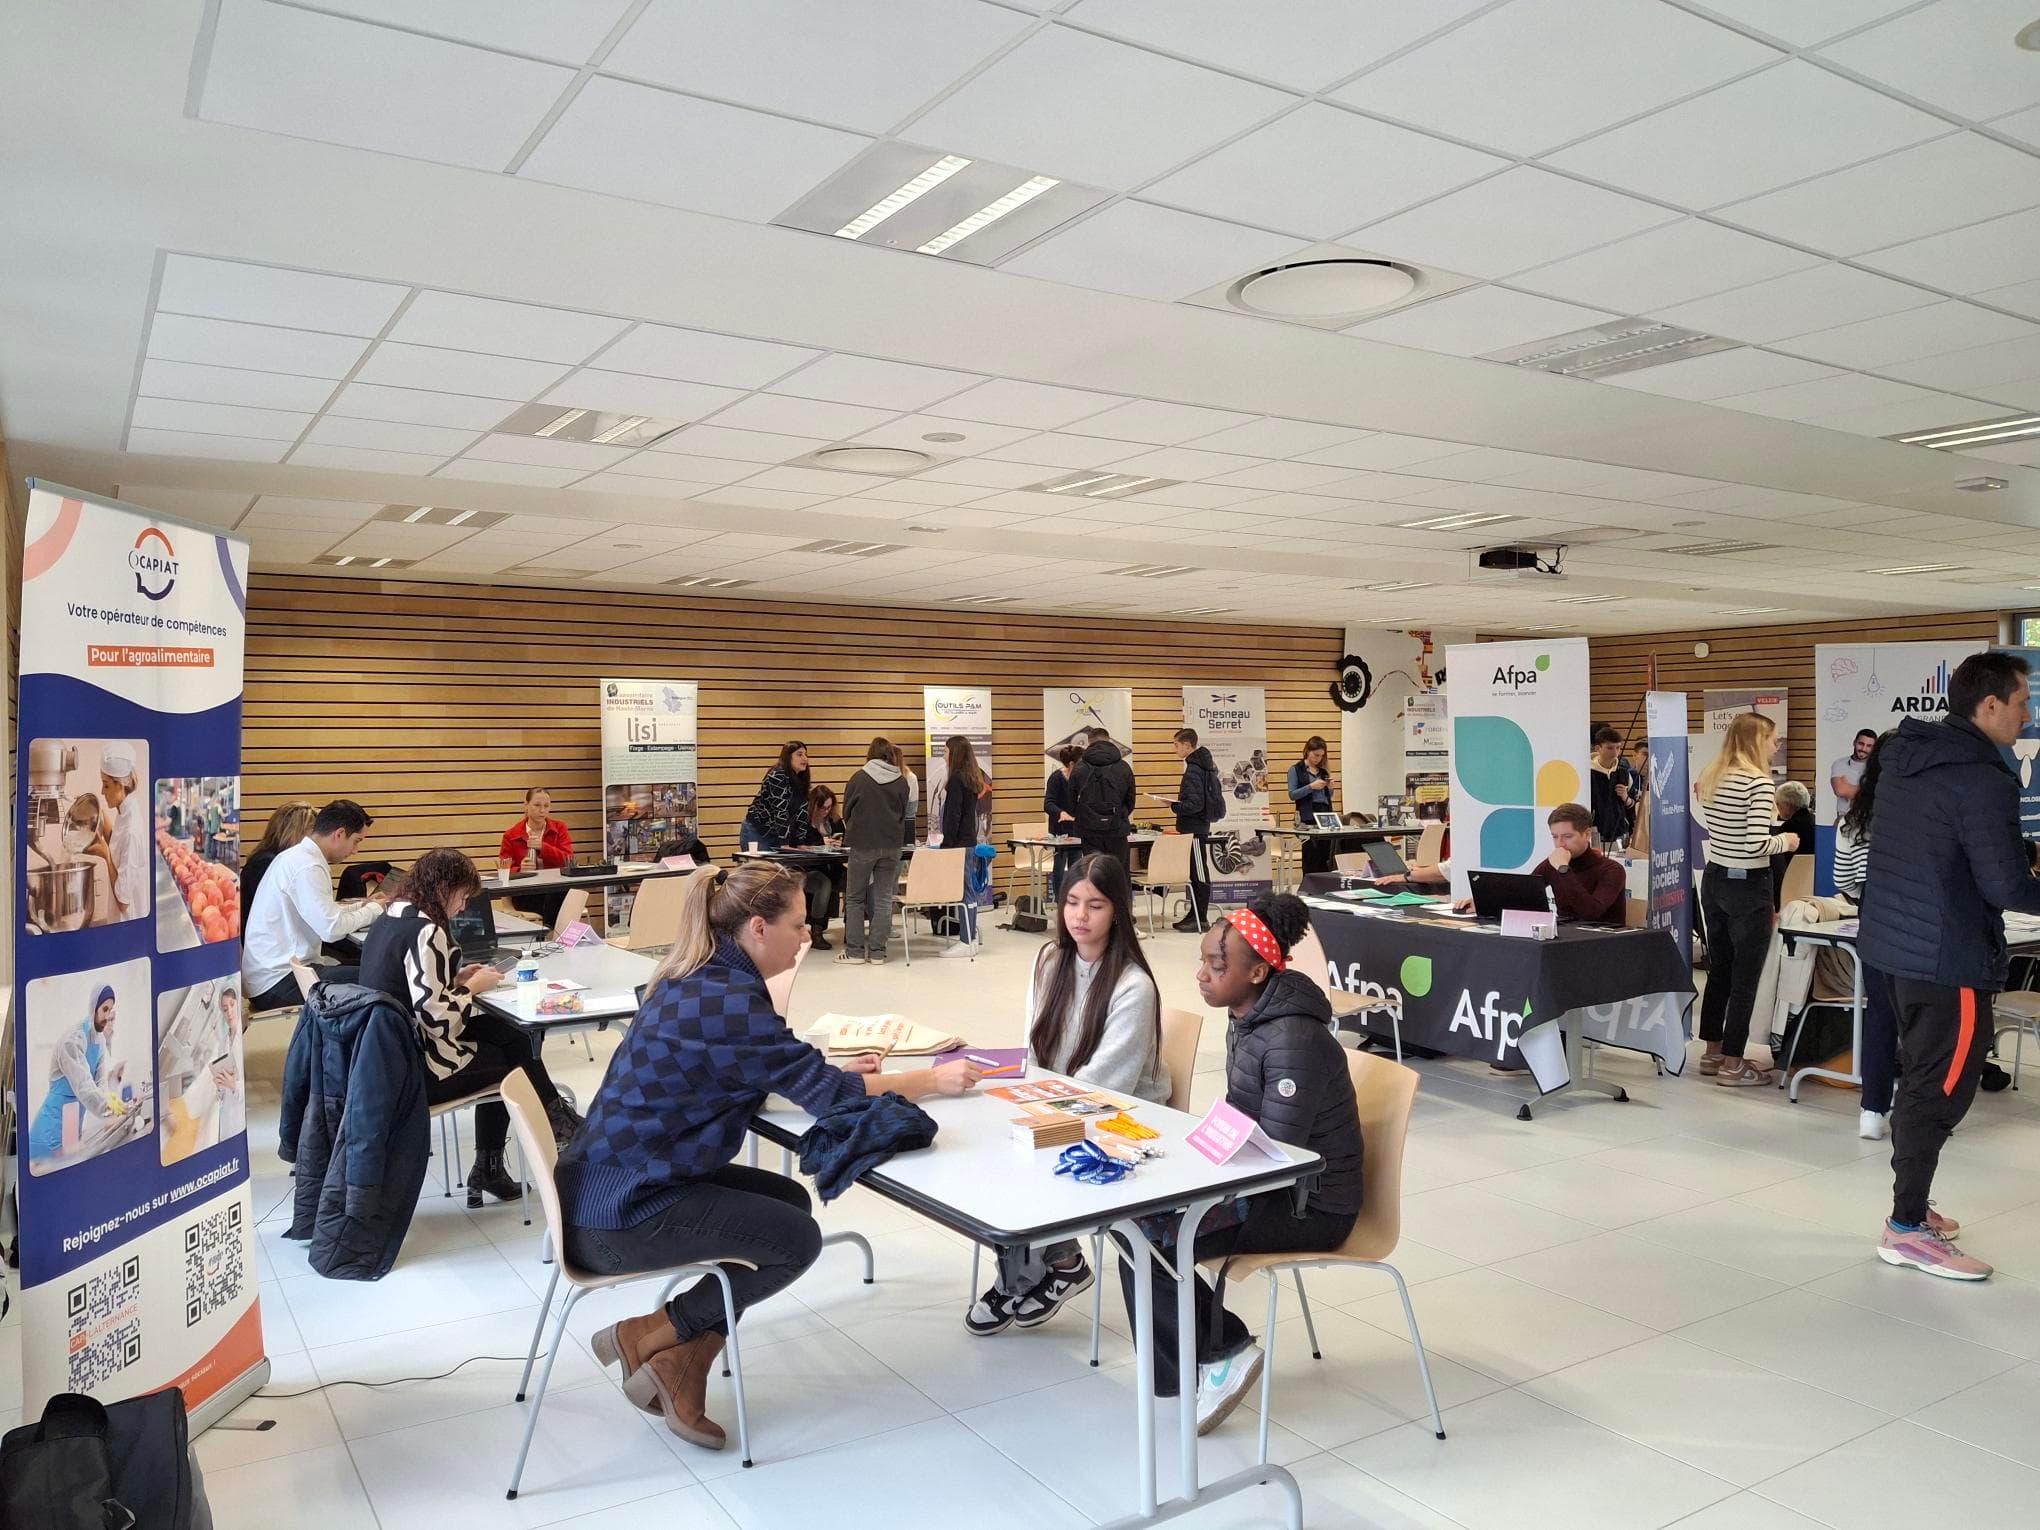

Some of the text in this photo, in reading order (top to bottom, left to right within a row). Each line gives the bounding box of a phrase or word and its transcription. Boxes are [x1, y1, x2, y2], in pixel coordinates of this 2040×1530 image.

[67, 602, 227, 637] Votre opérateur de compétences
[91, 648, 210, 665] Pour l'agroalimentaire
[1492, 664, 1537, 690] Afpa
[606, 698, 654, 706] INDUSTRIELS
[1890, 696, 1950, 713] ARDA
[1199, 708, 1250, 719] Chesneau
[1713, 711, 1733, 720] Let's
[1208, 719, 1242, 729] Serret
[1652, 847, 1685, 869] Pour une
[1661, 910, 1672, 927] un
[1448, 988, 1524, 1061] Afp
[63, 1158, 239, 1253] Rejoignez-nous sur www.ocapiat.fr
